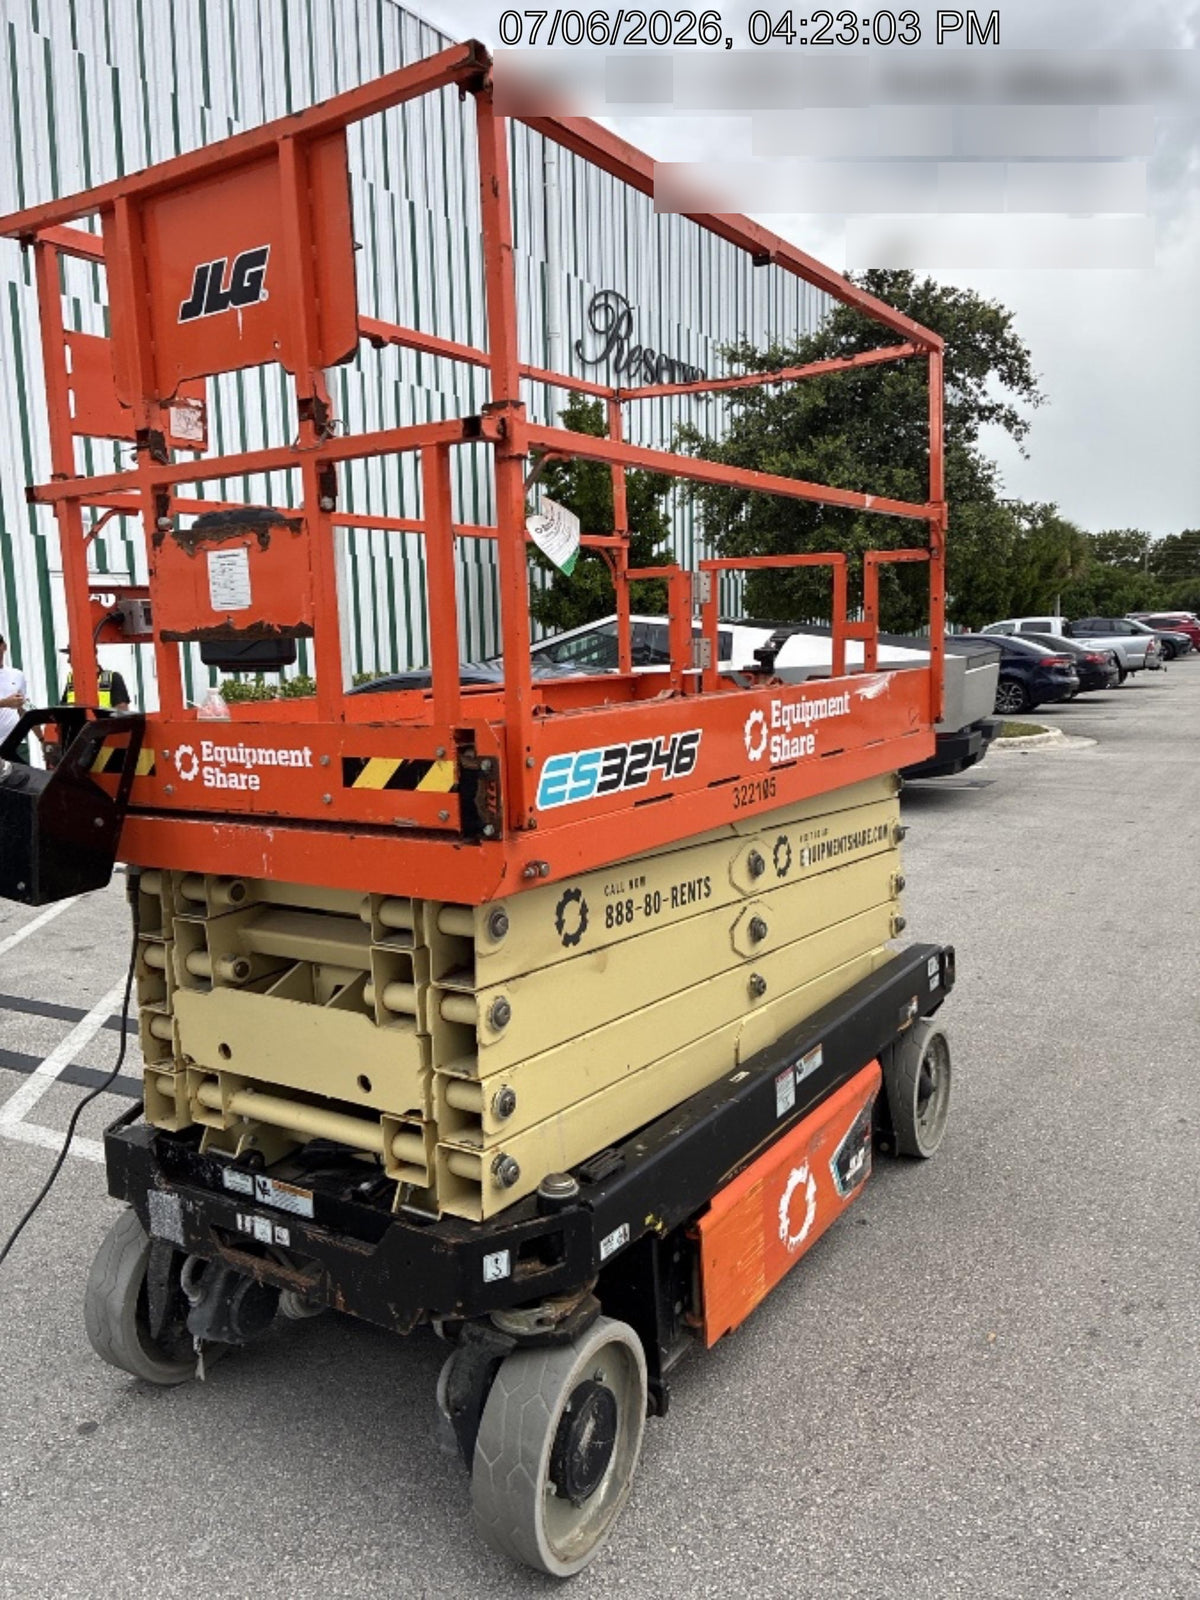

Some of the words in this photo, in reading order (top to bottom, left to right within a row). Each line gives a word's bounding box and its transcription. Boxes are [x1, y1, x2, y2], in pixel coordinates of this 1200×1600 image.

[177, 244, 270, 324] JLG
[771, 690, 850, 733] Equipment
[200, 741, 313, 769] Equipment
[770, 733, 816, 763] Share
[202, 766, 260, 791] Share
[536, 729, 703, 811] ES3246
[733, 776, 776, 809] 322105
[604, 882, 625, 897] CALL
[605, 876, 712, 929] 888-80-RENTS
